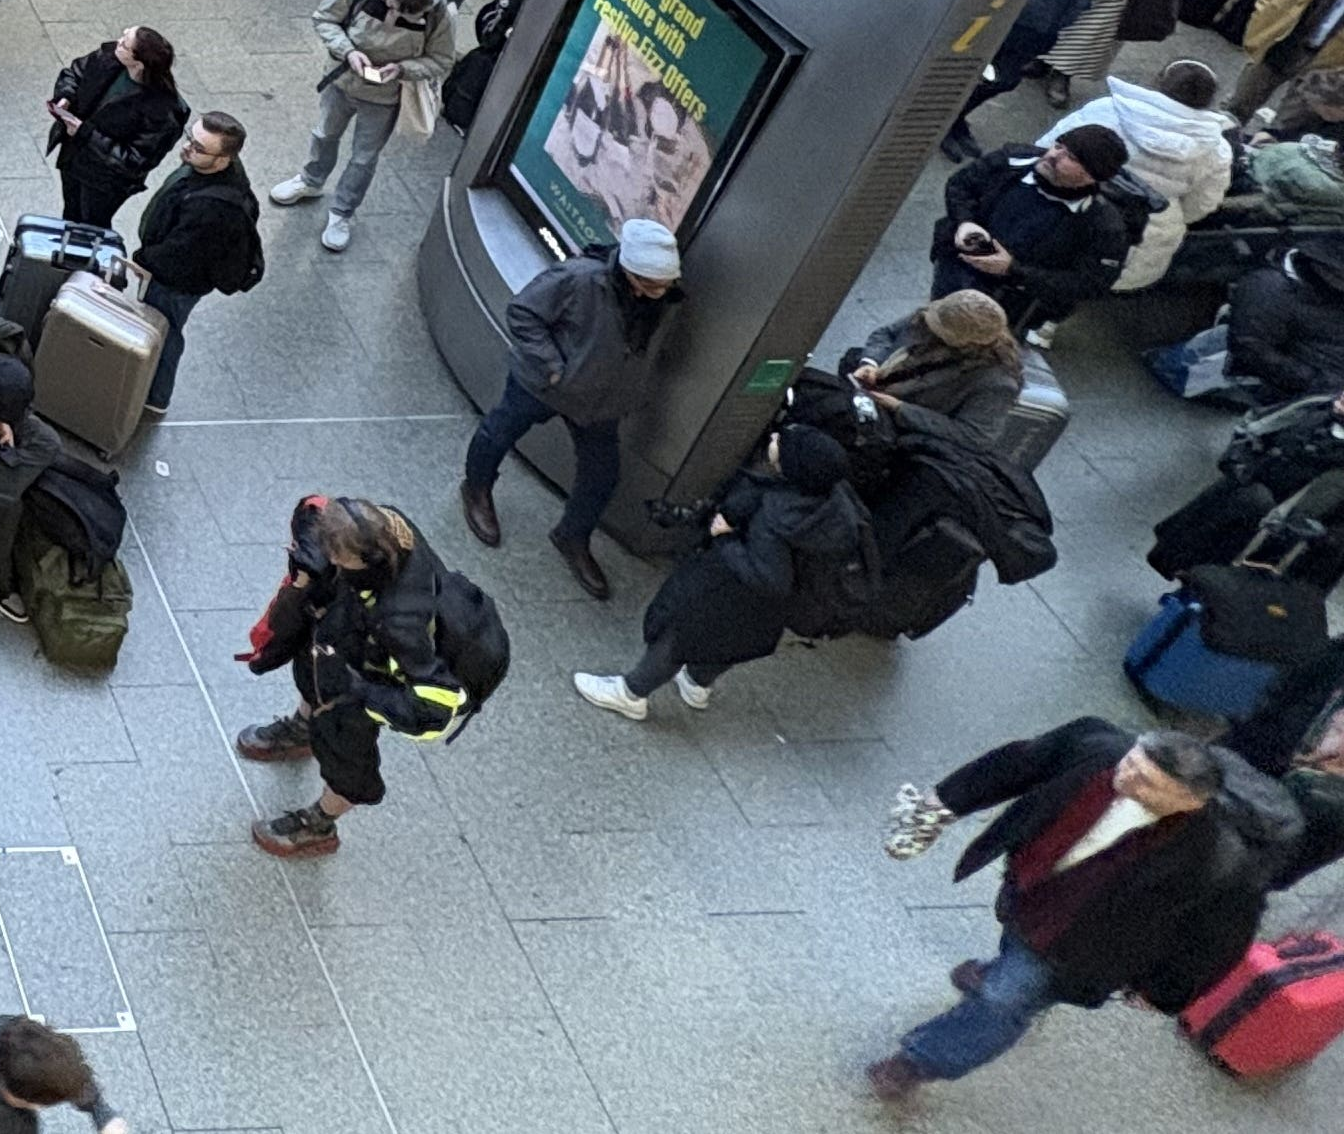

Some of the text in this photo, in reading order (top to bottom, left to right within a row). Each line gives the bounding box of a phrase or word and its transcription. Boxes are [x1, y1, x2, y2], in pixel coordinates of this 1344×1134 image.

[653, 17, 687, 60] with
[637, 36, 667, 78] Fizz
[662, 64, 708, 123] Offers
